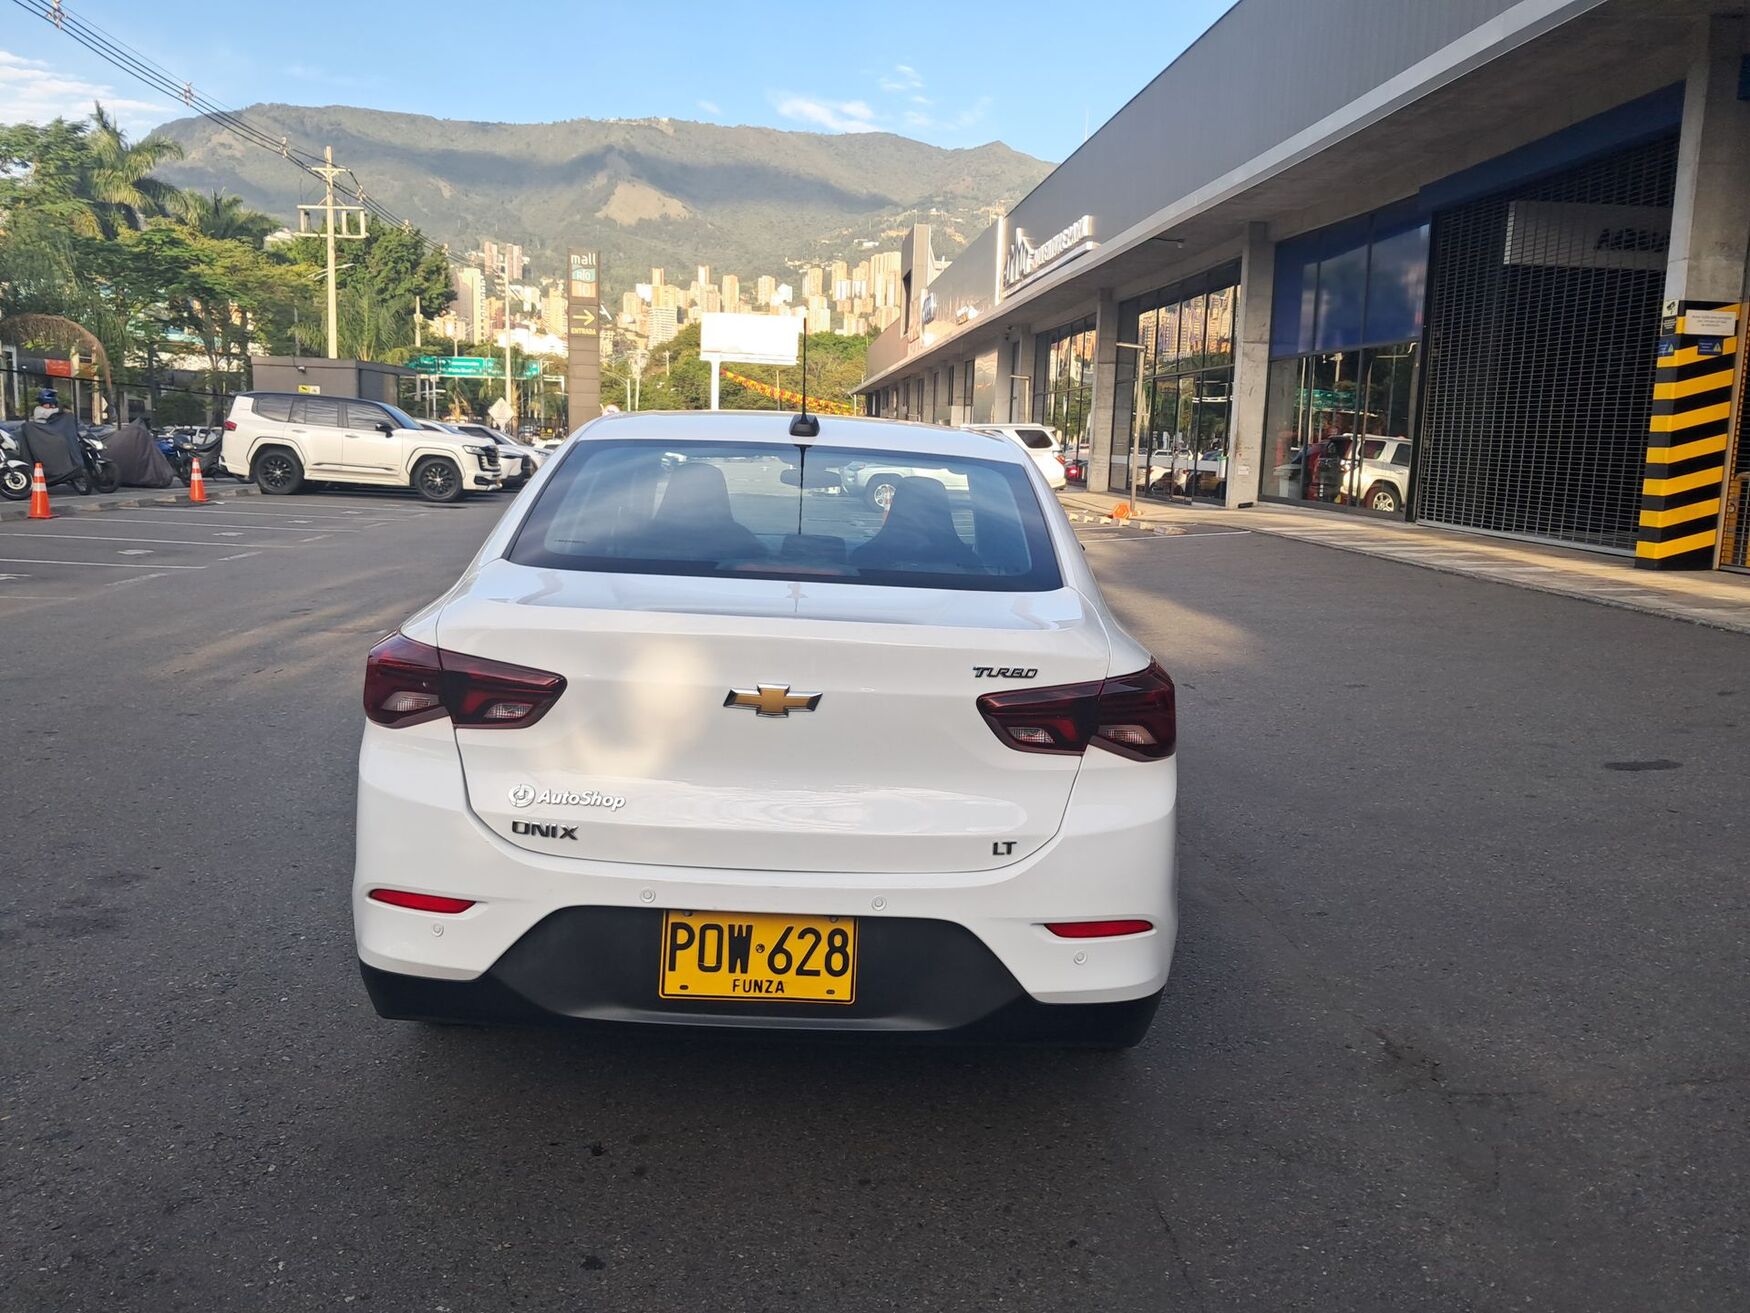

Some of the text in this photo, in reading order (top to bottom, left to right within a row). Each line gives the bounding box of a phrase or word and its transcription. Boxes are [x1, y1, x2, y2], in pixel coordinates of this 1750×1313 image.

[570, 252, 596, 266] mall
[972, 666, 1039, 679] TURBO
[537, 788, 627, 812] AutoShop
[511, 820, 579, 841] ONIX
[992, 841, 1018, 856] LT
[732, 978, 785, 994] FUNZA
